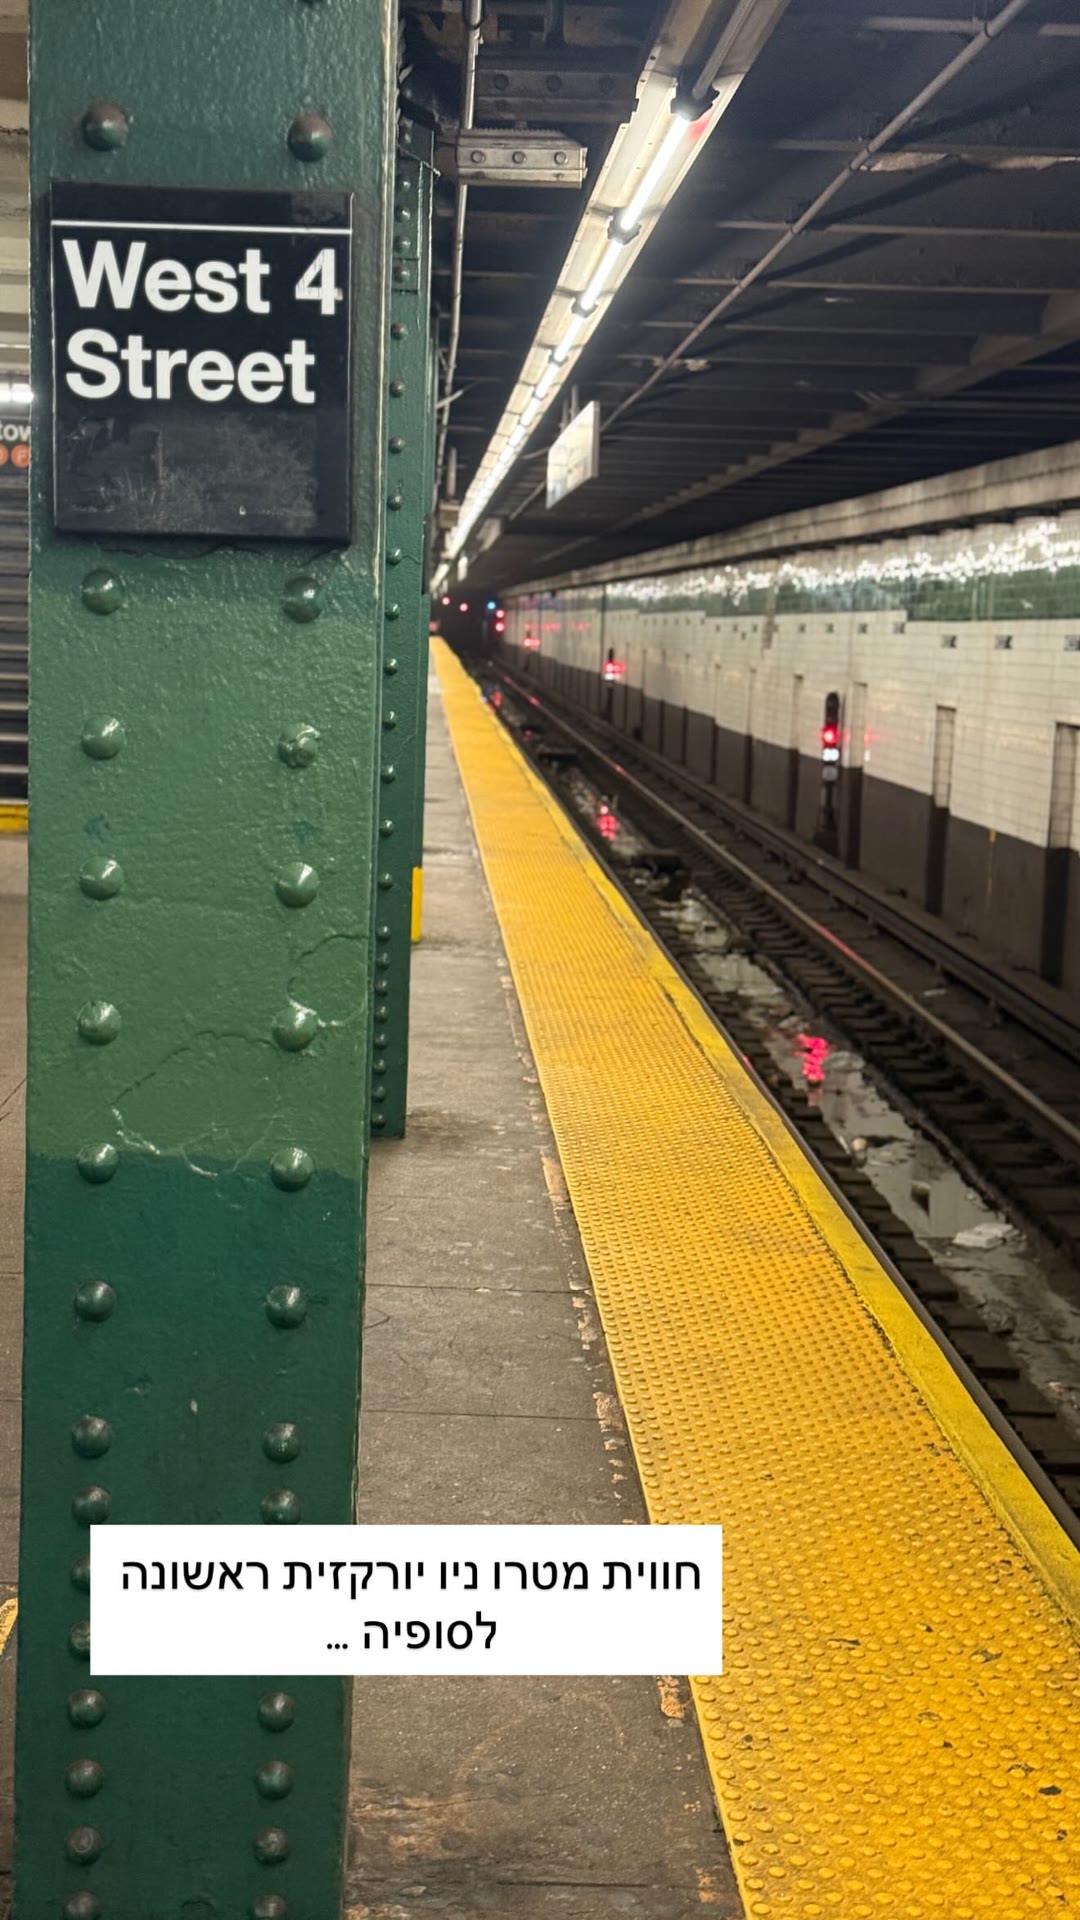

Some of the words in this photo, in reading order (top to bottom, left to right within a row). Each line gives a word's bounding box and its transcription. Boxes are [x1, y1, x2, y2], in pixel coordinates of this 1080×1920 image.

[62, 239, 271, 314] West
[295, 248, 343, 315] 4
[66, 328, 316, 404] Street
